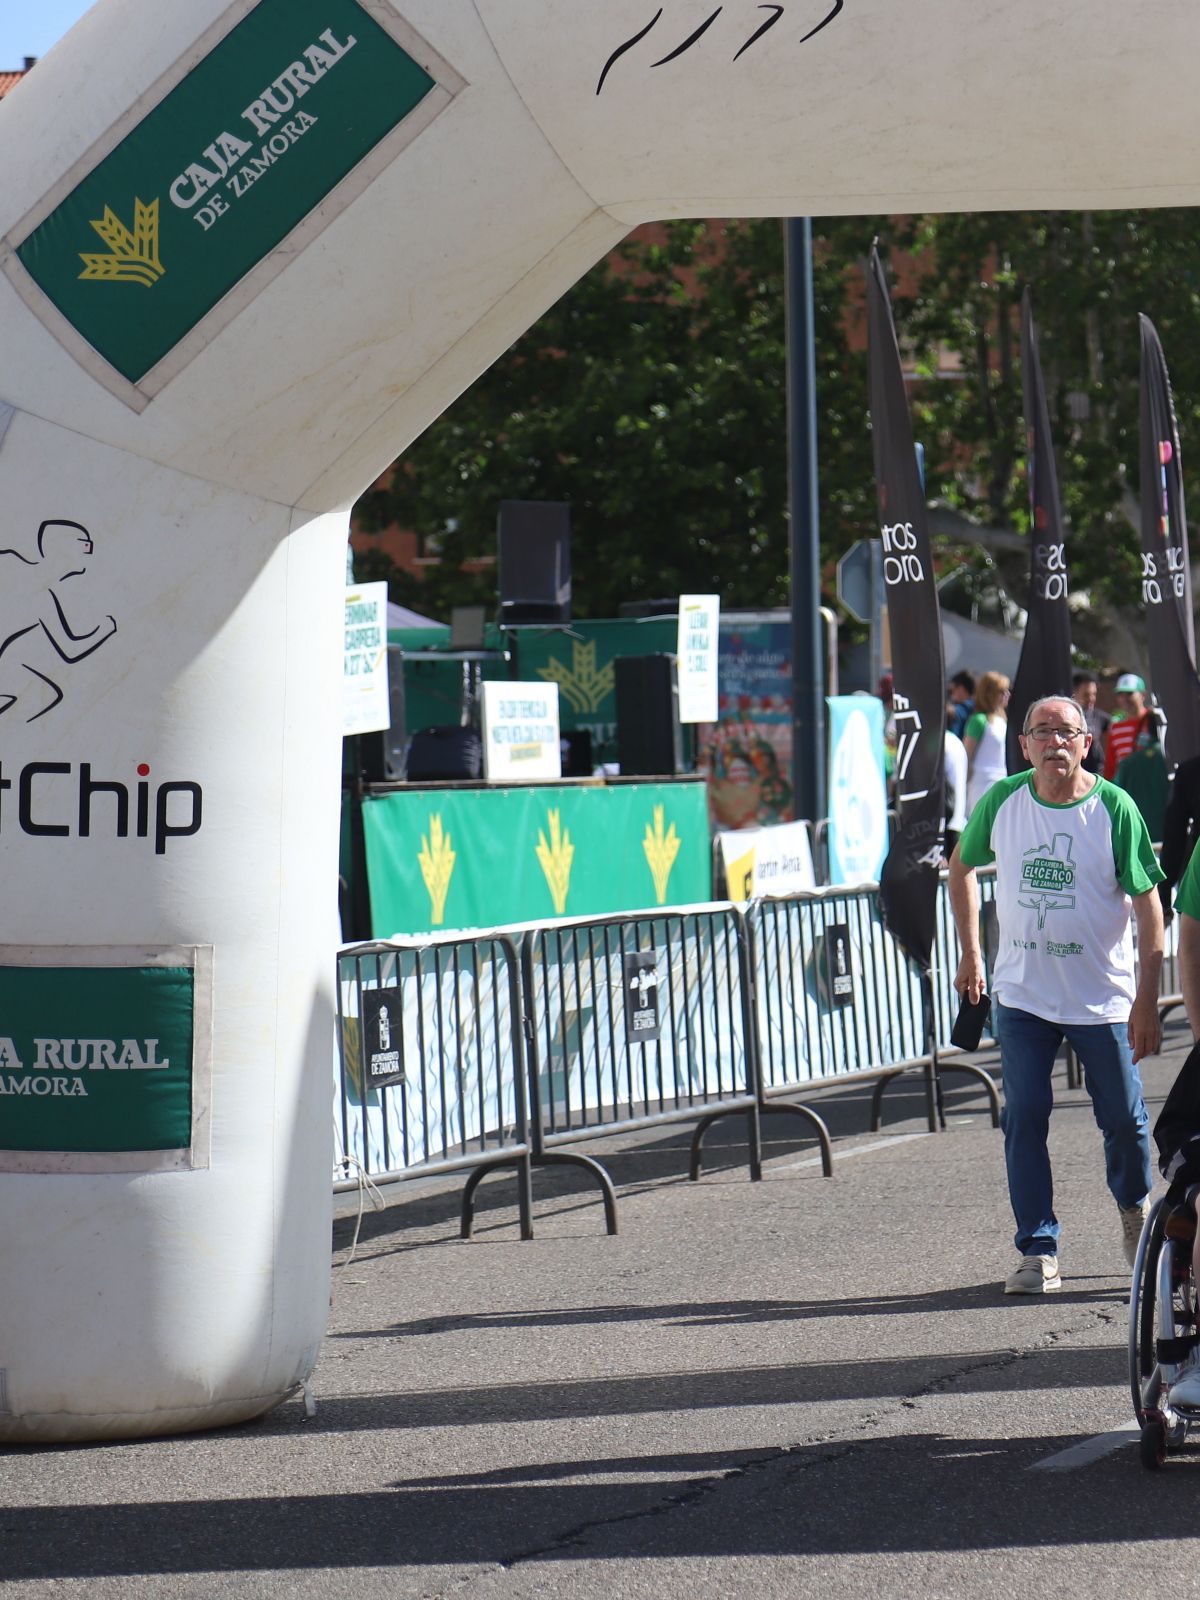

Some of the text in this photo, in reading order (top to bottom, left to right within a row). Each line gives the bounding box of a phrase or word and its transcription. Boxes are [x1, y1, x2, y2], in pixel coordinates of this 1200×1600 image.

[170, 28, 357, 209] CAJA RURAL
[193, 110, 318, 231] DE ZAMORA
[1038, 867, 1072, 883] CERCO
[1041, 860, 1063, 870] CARRERA
[1041, 880, 1062, 890] ZAMORA
[33, 1038, 170, 1070] RURAL
